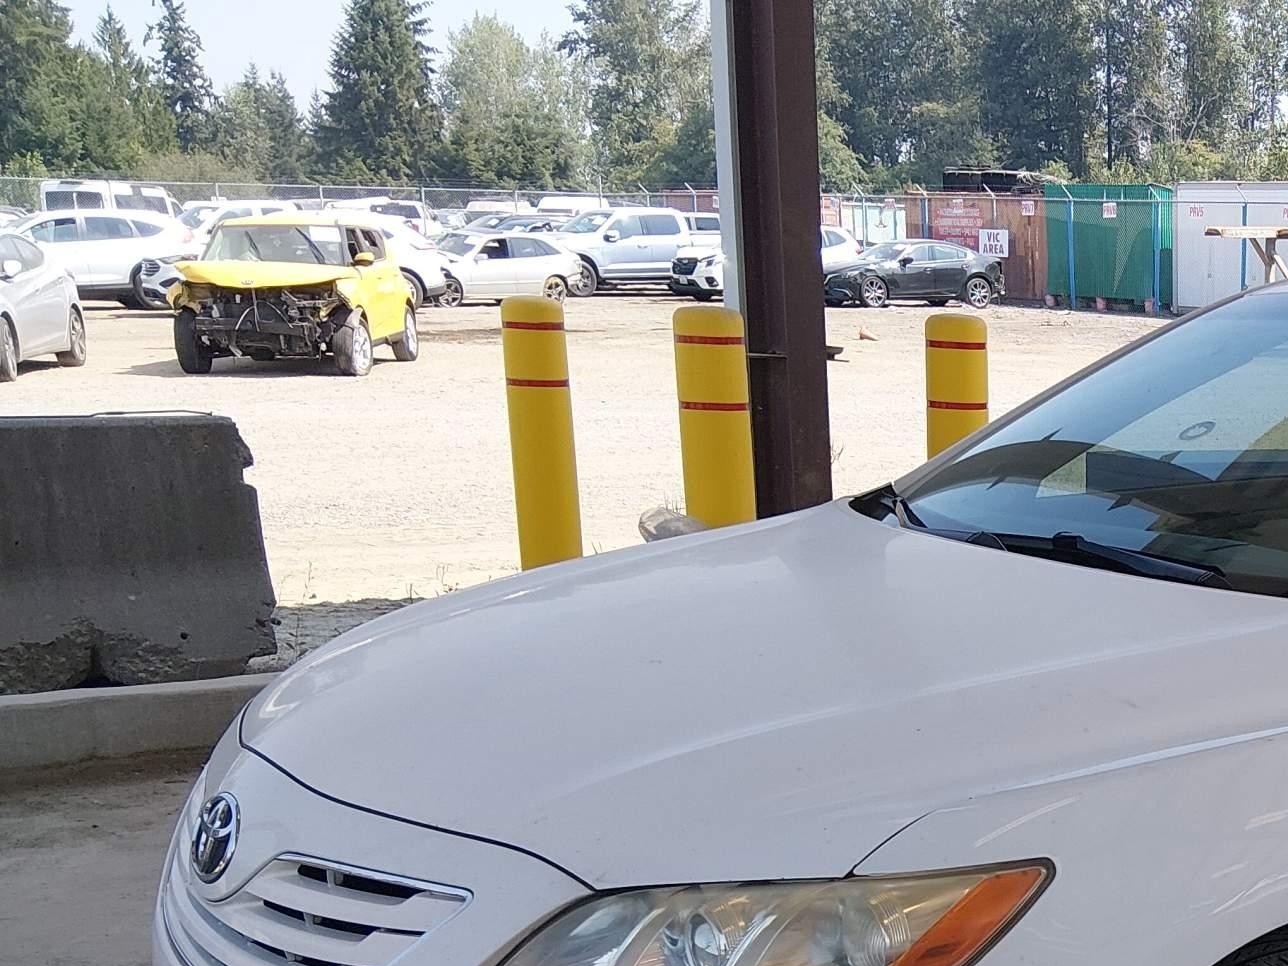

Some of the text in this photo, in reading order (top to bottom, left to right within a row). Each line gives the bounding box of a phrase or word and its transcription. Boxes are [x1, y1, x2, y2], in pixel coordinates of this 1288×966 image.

[1189, 206, 1204, 217] PRV5
[986, 232, 1000, 243] VIC
[982, 244, 1005, 255] AREA
